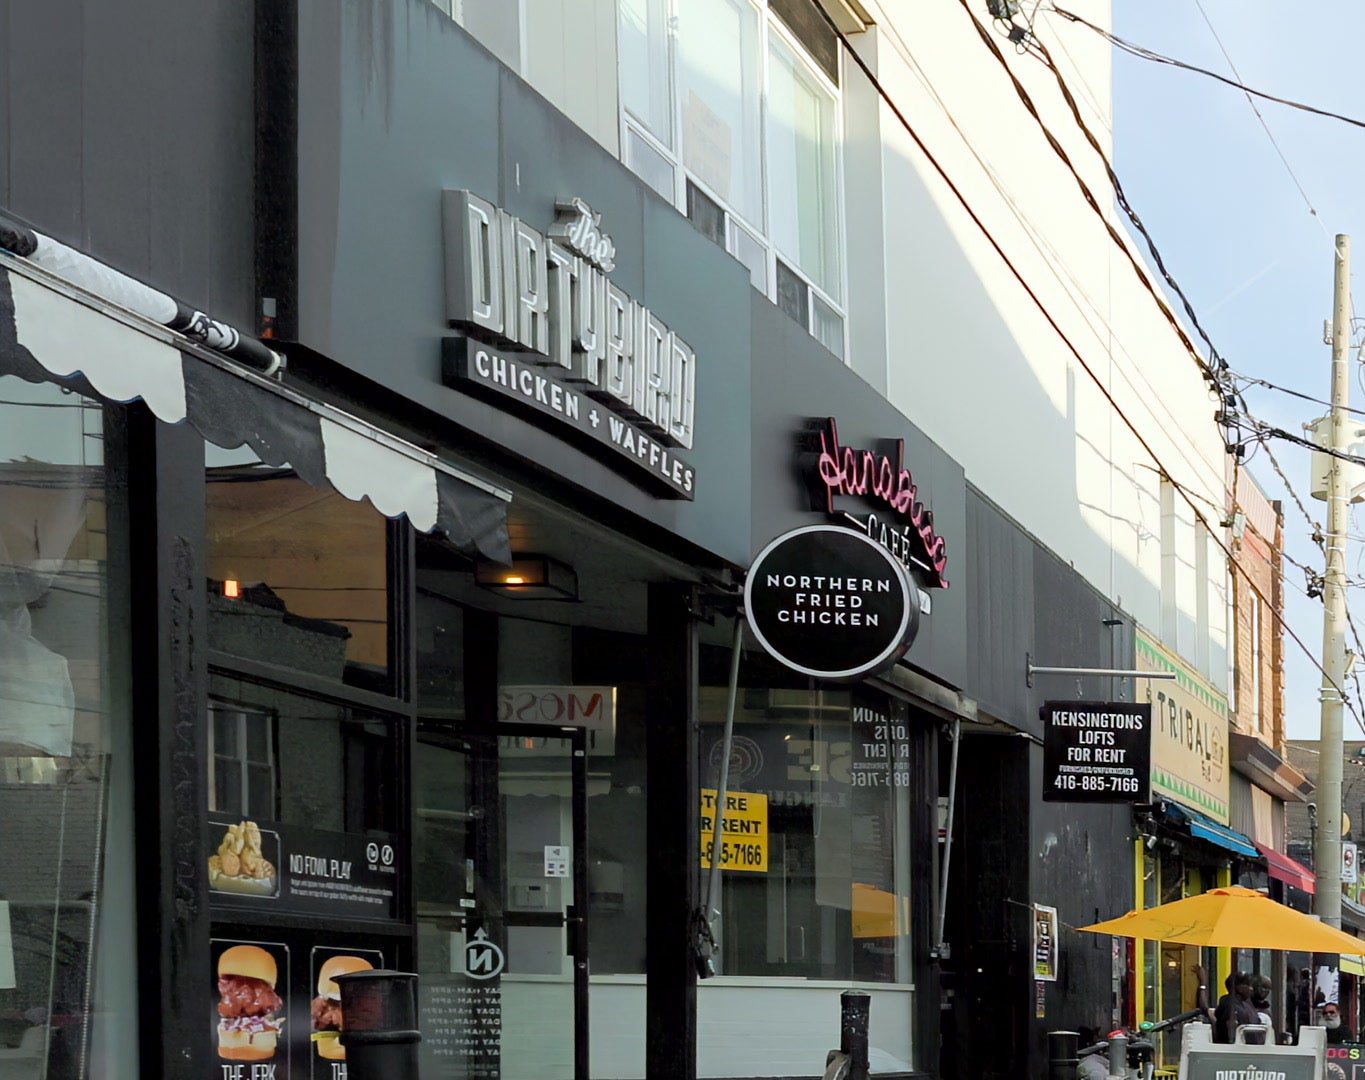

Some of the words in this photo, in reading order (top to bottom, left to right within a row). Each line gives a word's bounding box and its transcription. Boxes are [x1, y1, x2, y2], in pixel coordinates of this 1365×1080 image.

[460, 189, 697, 449] DIRTYBIRD
[474, 350, 580, 421] CHICKEN
[609, 415, 693, 493] WAFFLES
[767, 574, 891, 593] NORTHERN
[795, 593, 863, 608] FRIED
[777, 610, 879, 627] CHICKEN
[1052, 711, 1143, 730] KENSINGTONS
[1157, 691, 1212, 761] TRIBAL
[1079, 730, 1115, 745] LOFTS
[1067, 747, 1091, 762] FOR
[1094, 749, 1126, 763] RENT
[1054, 775, 1139, 792] 416-885-7166
[290, 854, 303, 874] NO
[305, 856, 330, 878] FOWL
[331, 860, 352, 879] PLAY
